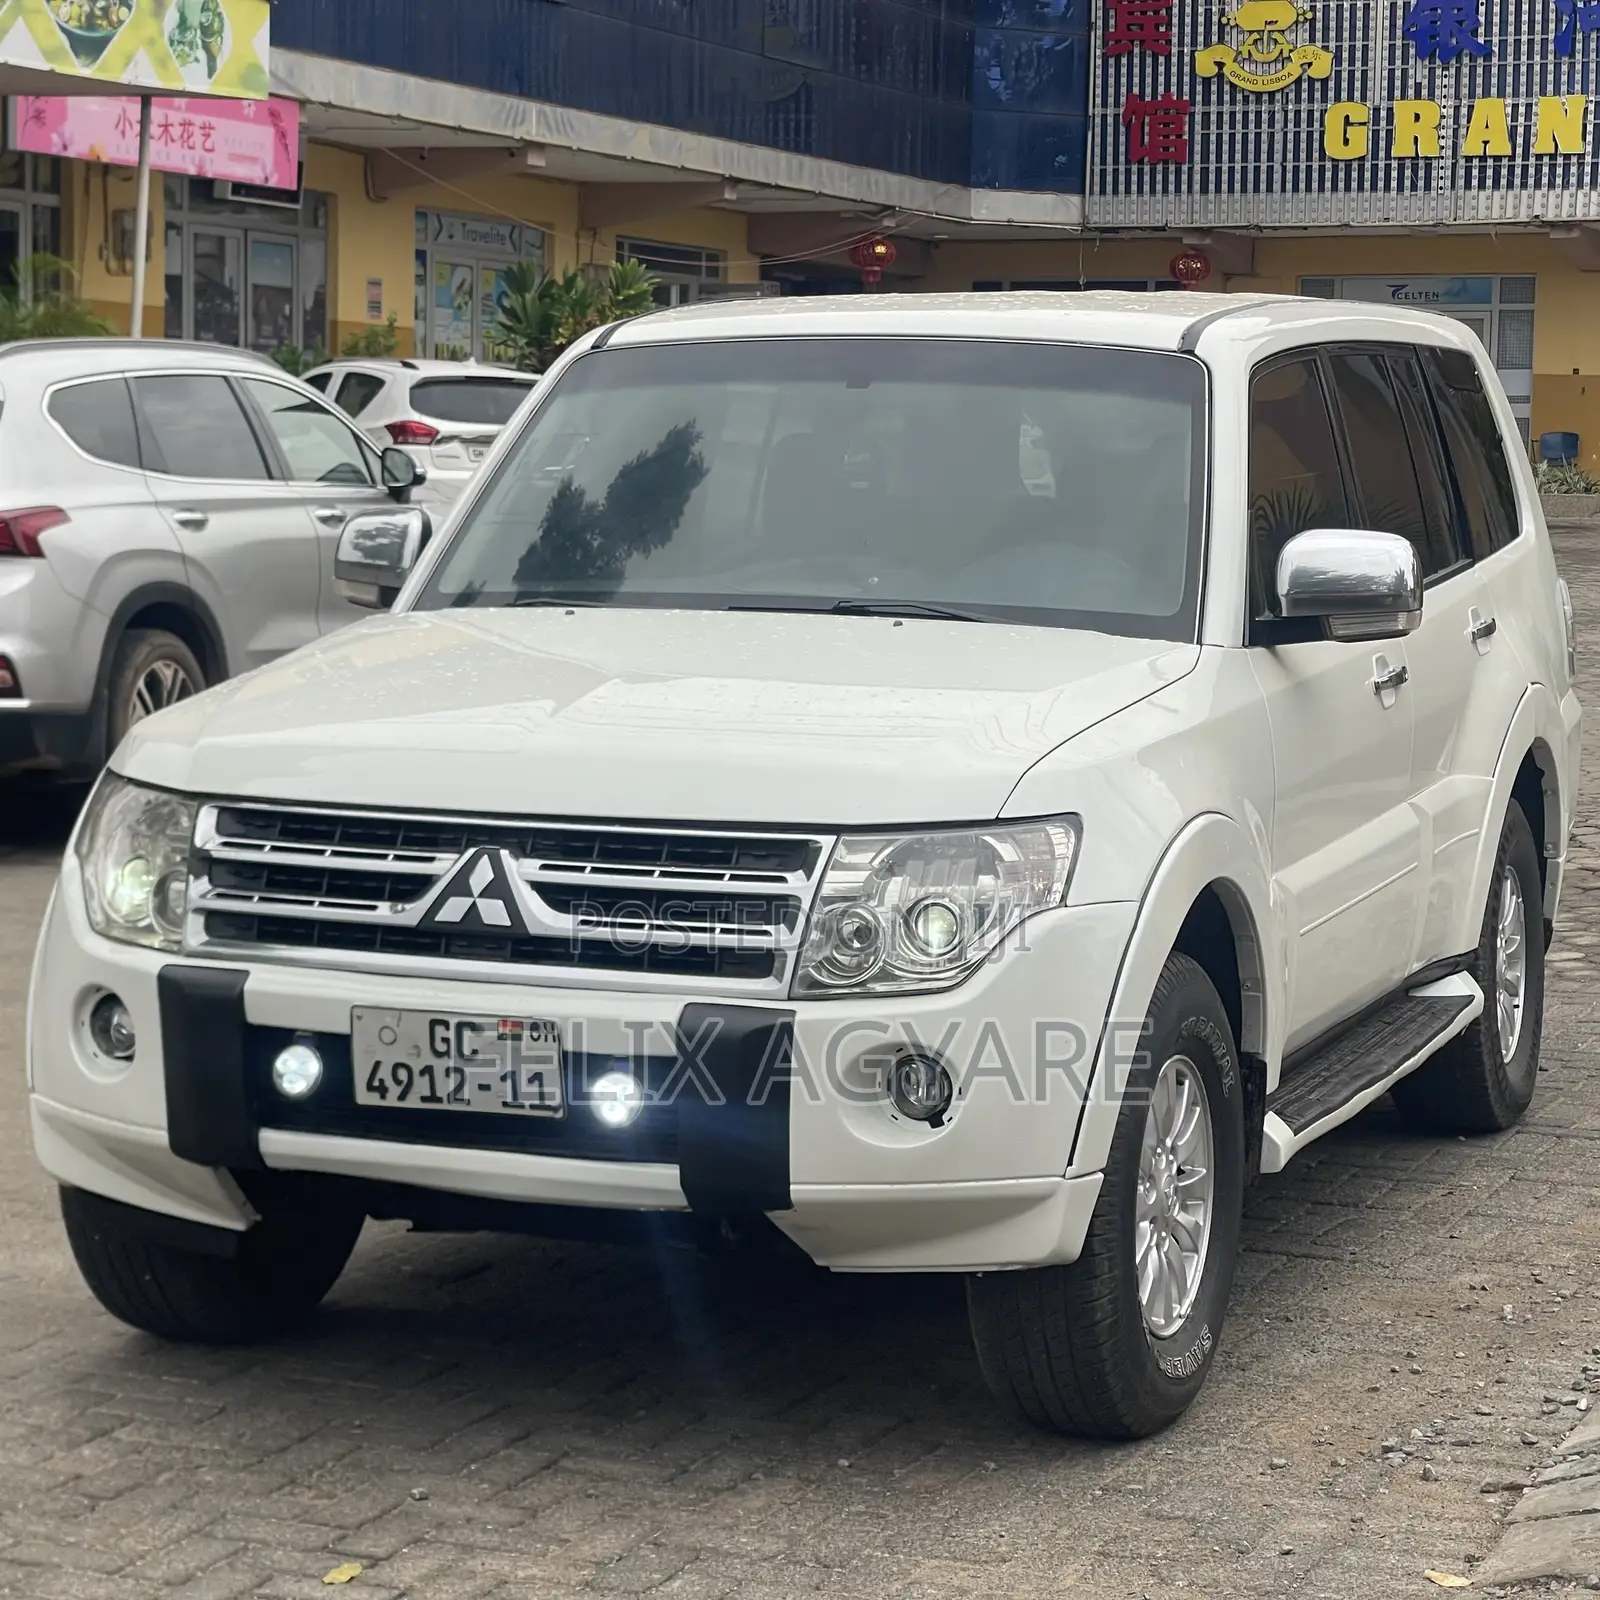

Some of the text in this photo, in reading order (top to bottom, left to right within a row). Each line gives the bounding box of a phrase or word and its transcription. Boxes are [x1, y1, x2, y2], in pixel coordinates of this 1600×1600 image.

[1229, 69, 1294, 87] GRAND LISBOA
[1323, 94, 1588, 160] GRAN
[461, 222, 508, 246] Travelite
[1396, 291, 1439, 300] CELTEN
[428, 1018, 480, 1061] GC
[365, 1059, 562, 1112] 4912-11
